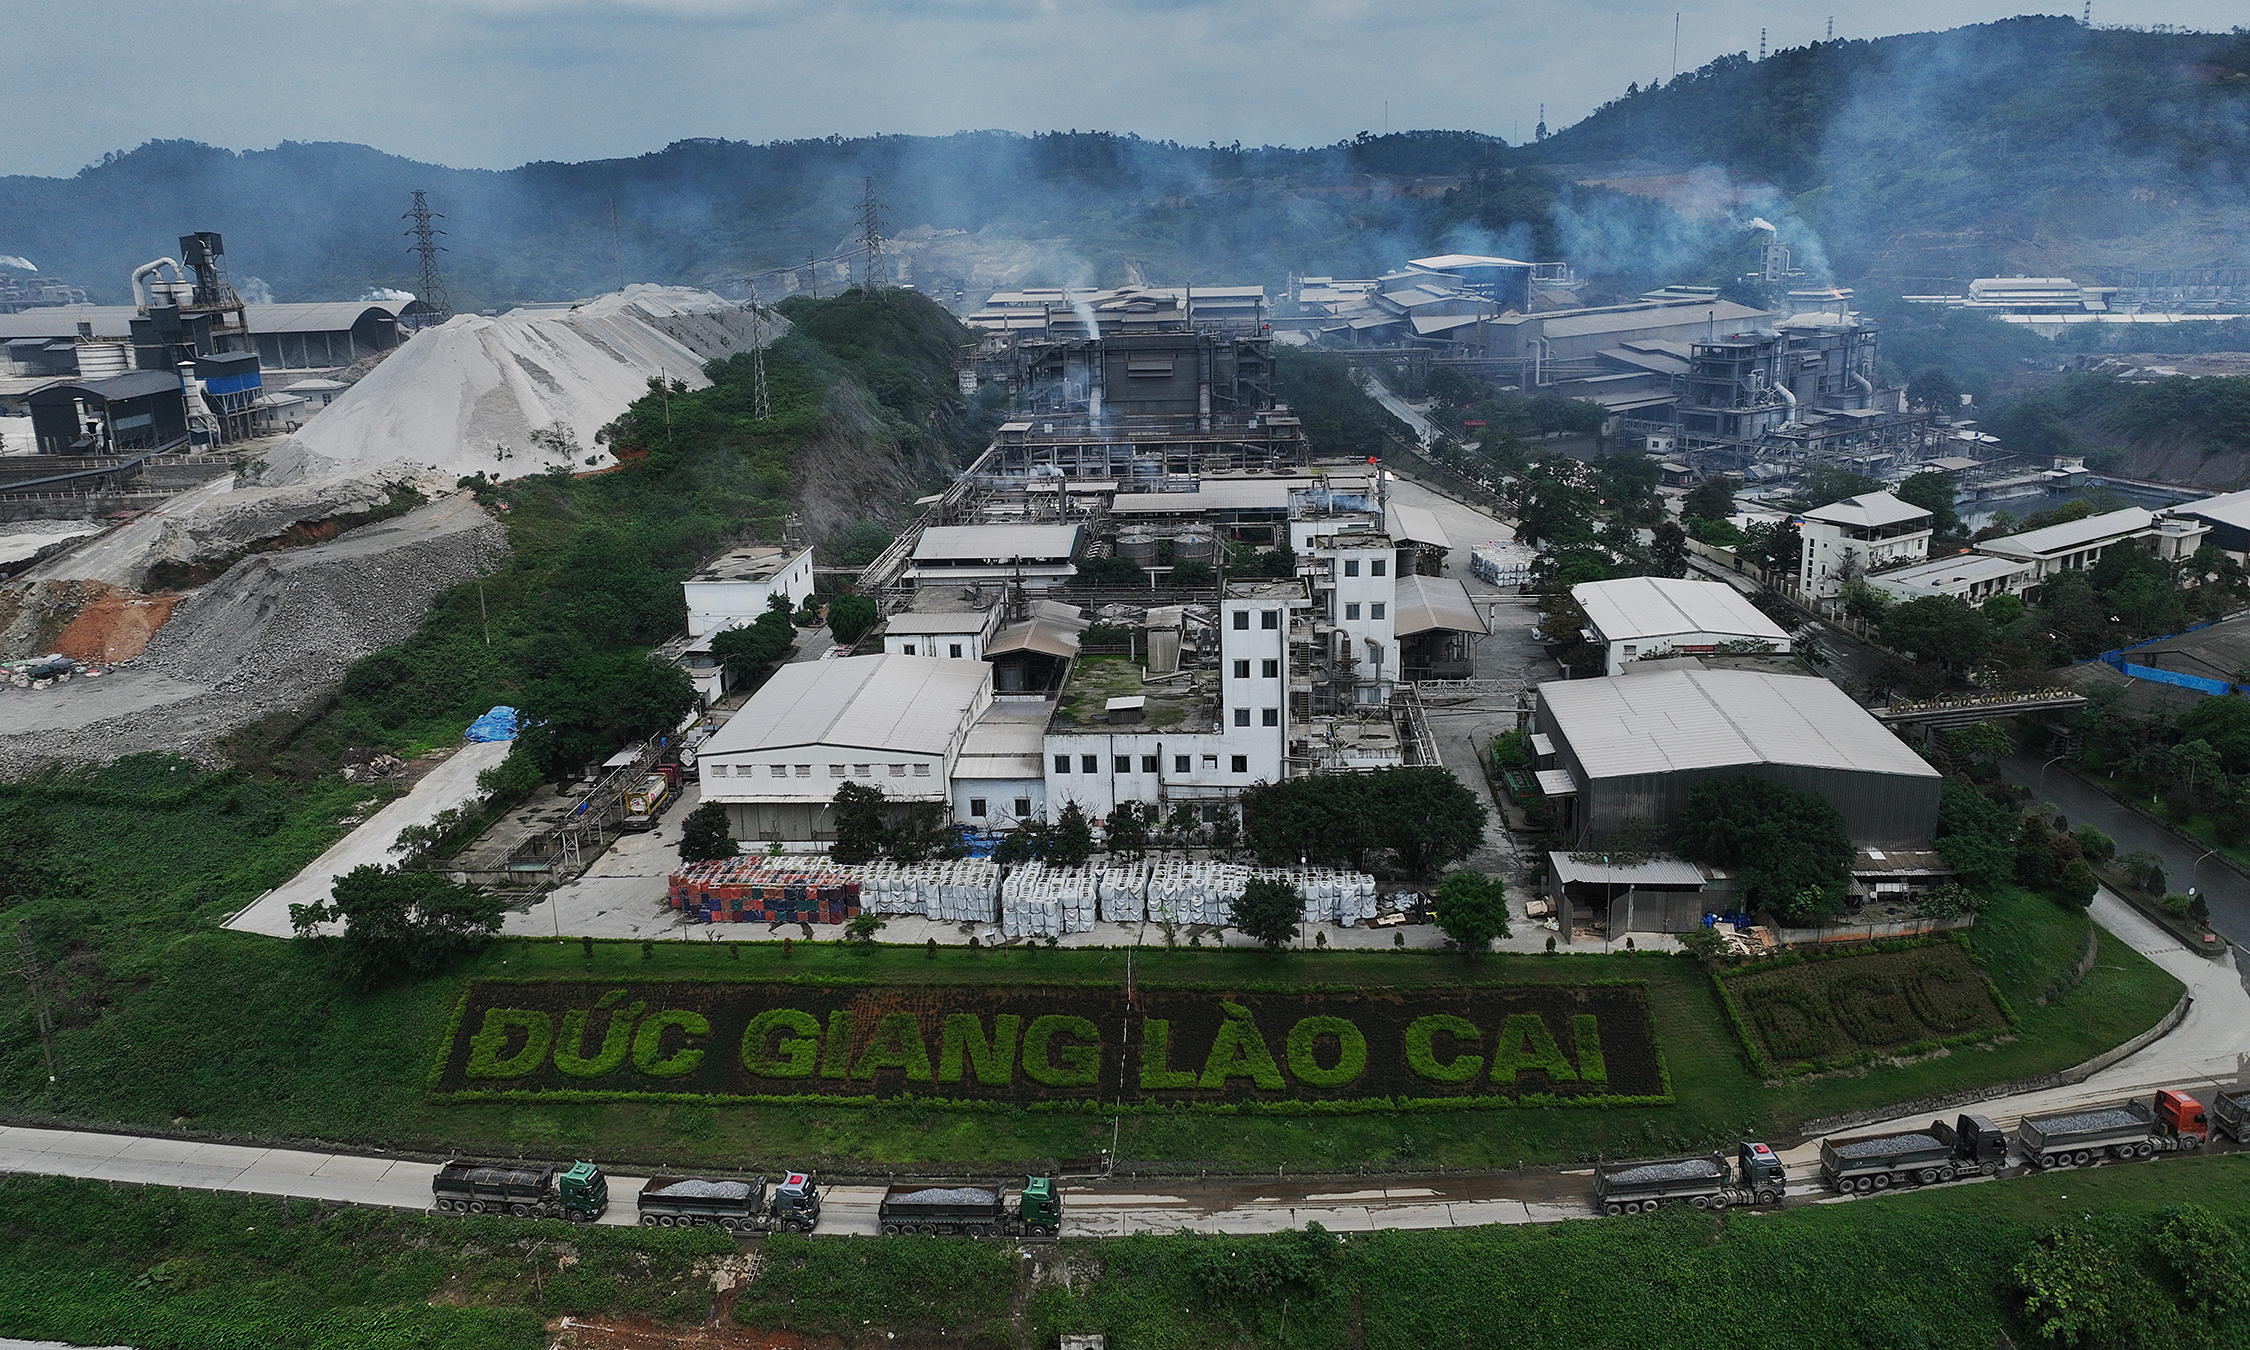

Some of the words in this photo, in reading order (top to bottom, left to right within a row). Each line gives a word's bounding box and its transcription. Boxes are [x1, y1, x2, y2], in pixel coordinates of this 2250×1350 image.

[1980, 690, 2018, 704] GIANG
[466, 989, 710, 1079] ĐỨC
[741, 1008, 1101, 1088] GIANG
[1139, 999, 1367, 1090] LÀO
[1404, 1013, 1607, 1086] CAI
